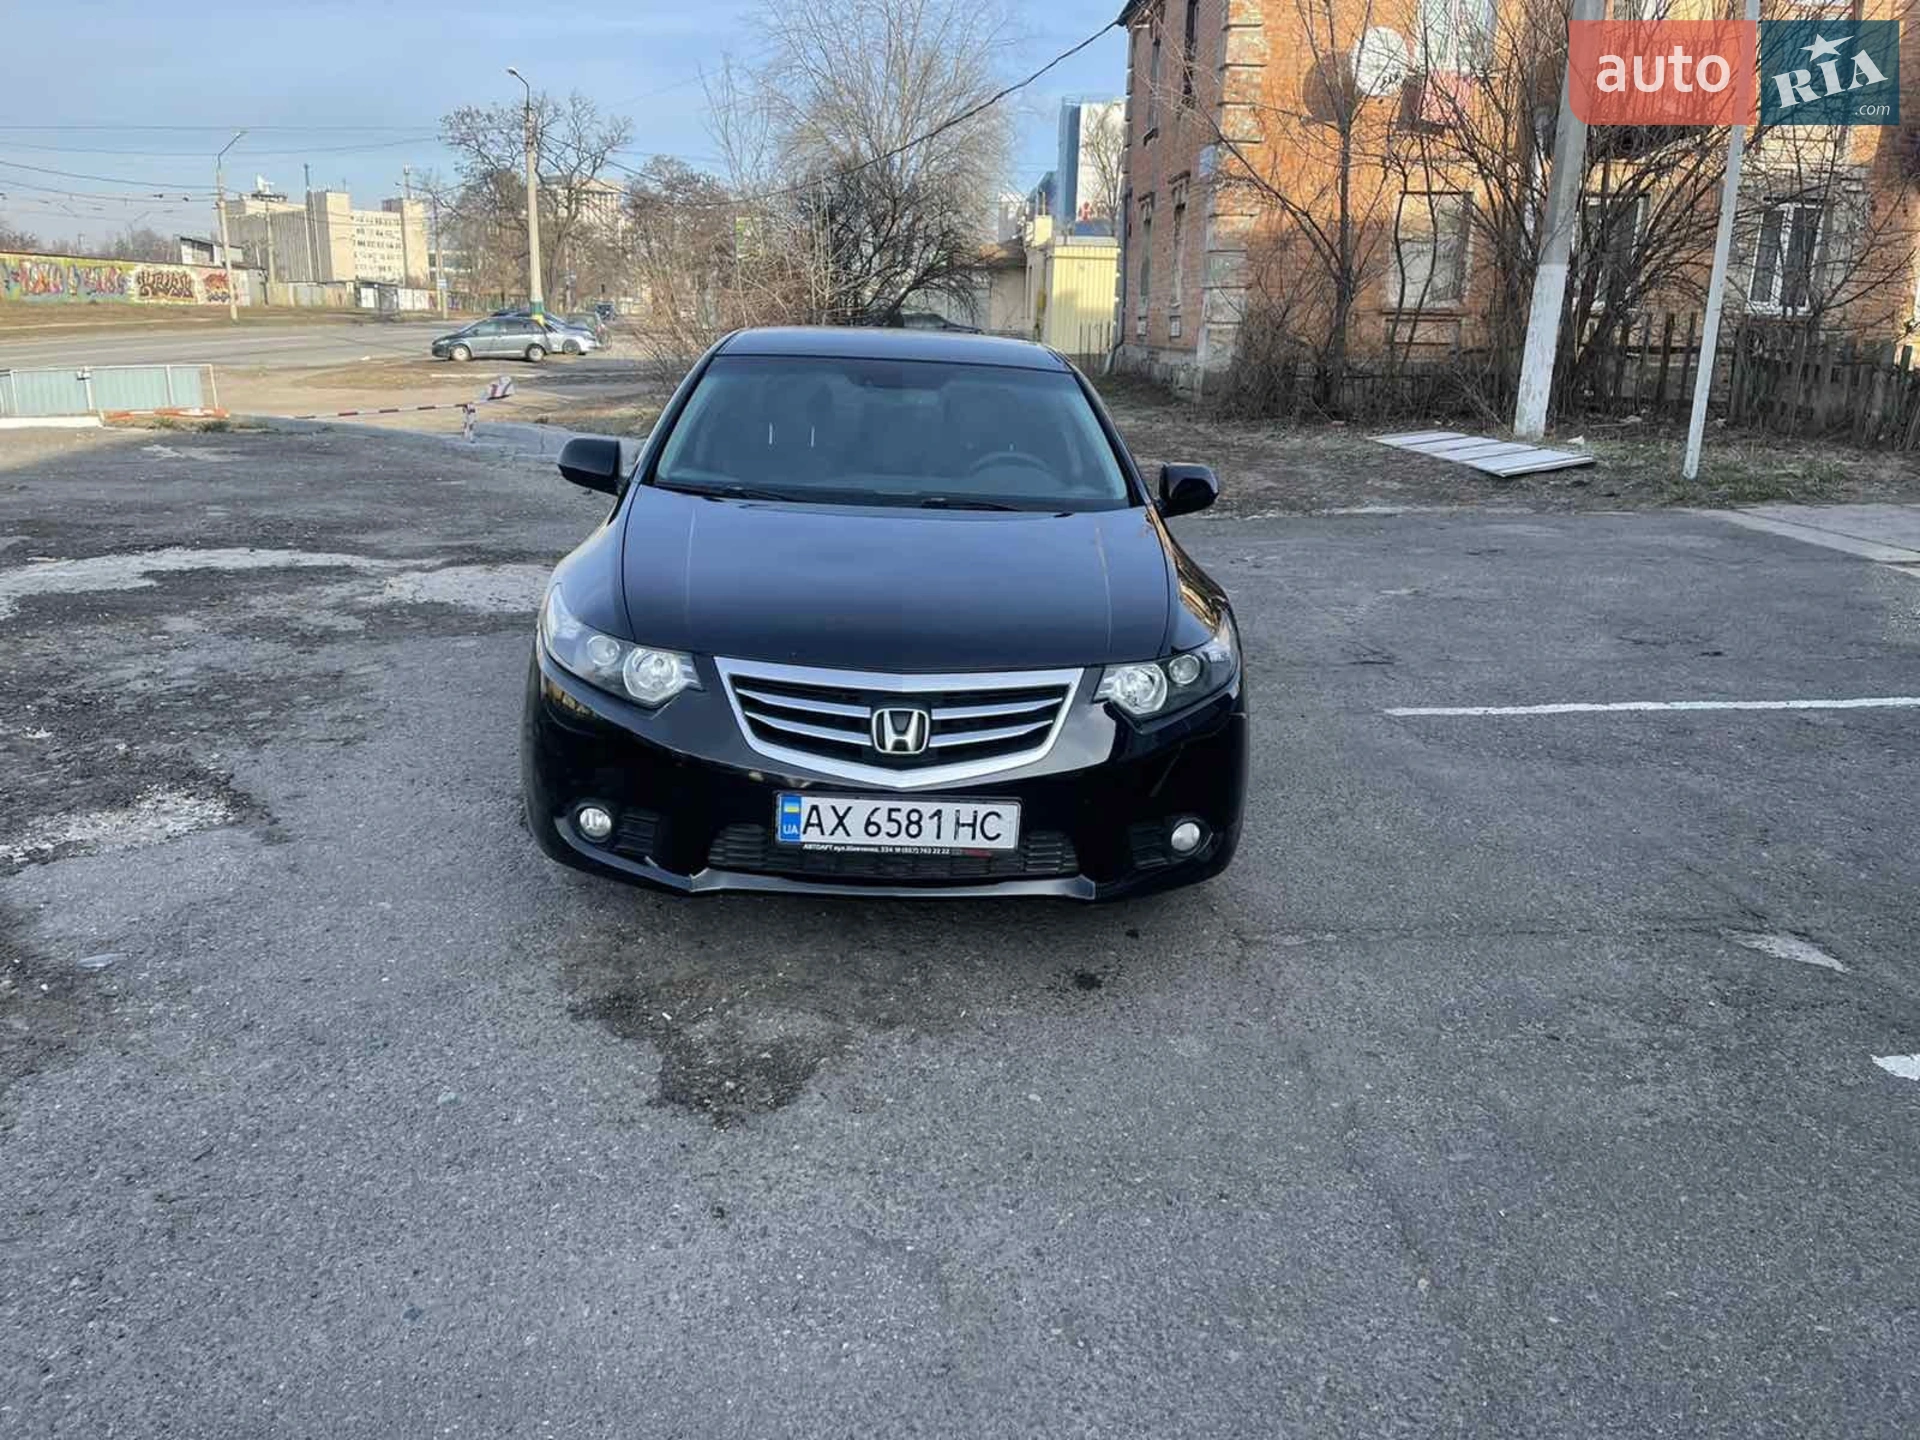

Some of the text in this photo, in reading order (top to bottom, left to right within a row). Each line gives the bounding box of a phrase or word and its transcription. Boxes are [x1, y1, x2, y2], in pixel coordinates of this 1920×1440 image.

[783, 824, 799, 835] UA
[802, 805, 1002, 841] AX 6581 HC
